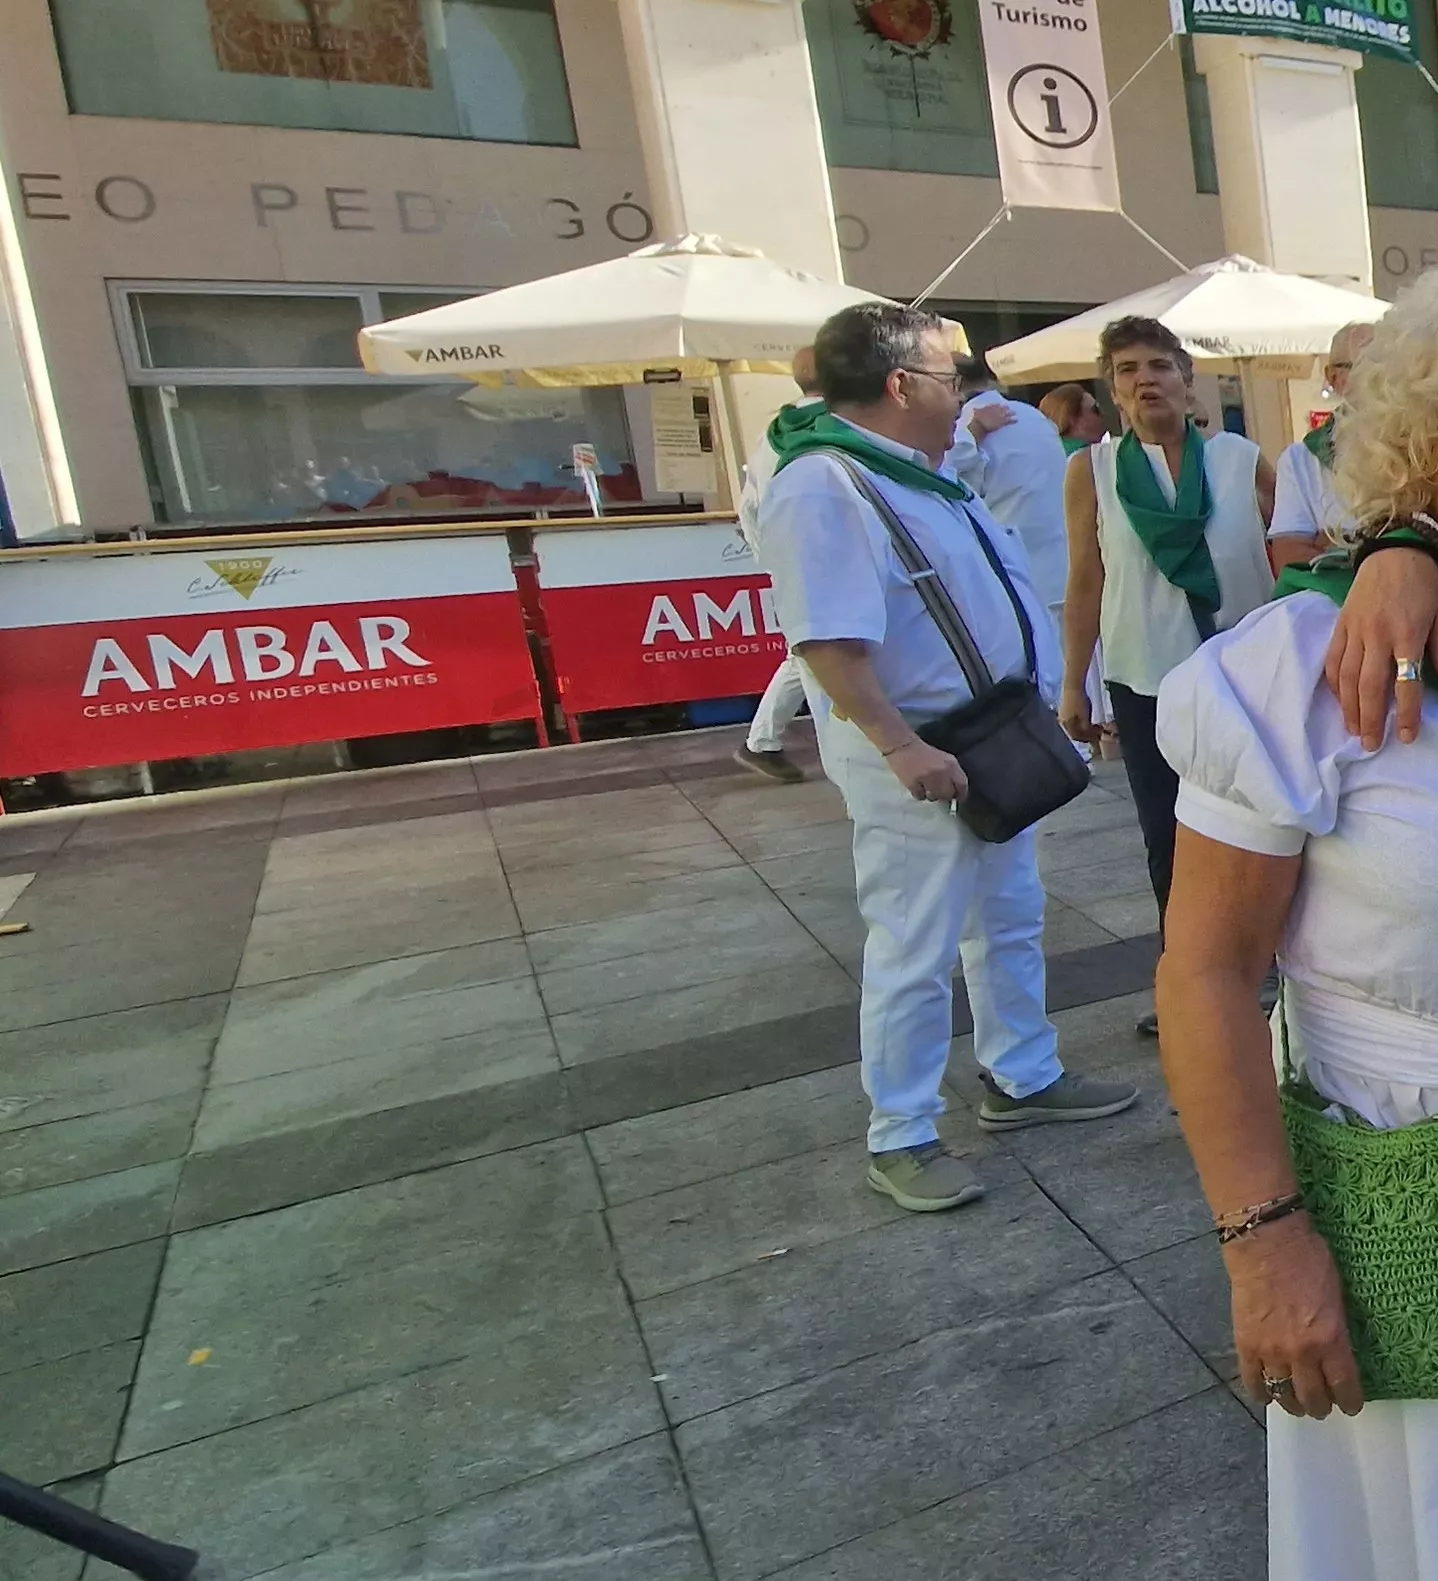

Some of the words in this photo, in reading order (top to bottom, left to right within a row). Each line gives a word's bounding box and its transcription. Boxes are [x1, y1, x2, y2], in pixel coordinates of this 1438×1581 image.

[991, 2, 1088, 32] Turismo
[1192, 0, 1301, 20] ALCOHOL
[1305, 4, 1321, 23] A
[1324, 7, 1411, 43] MENORES
[425, 344, 505, 363] AMBAR
[219, 560, 262, 571] 1900
[81, 616, 434, 697] AMBAR
[642, 643, 760, 663] CERVECEROS
[83, 691, 241, 718] CERVECEROS
[250, 672, 439, 701] INDEPENDIENTES
